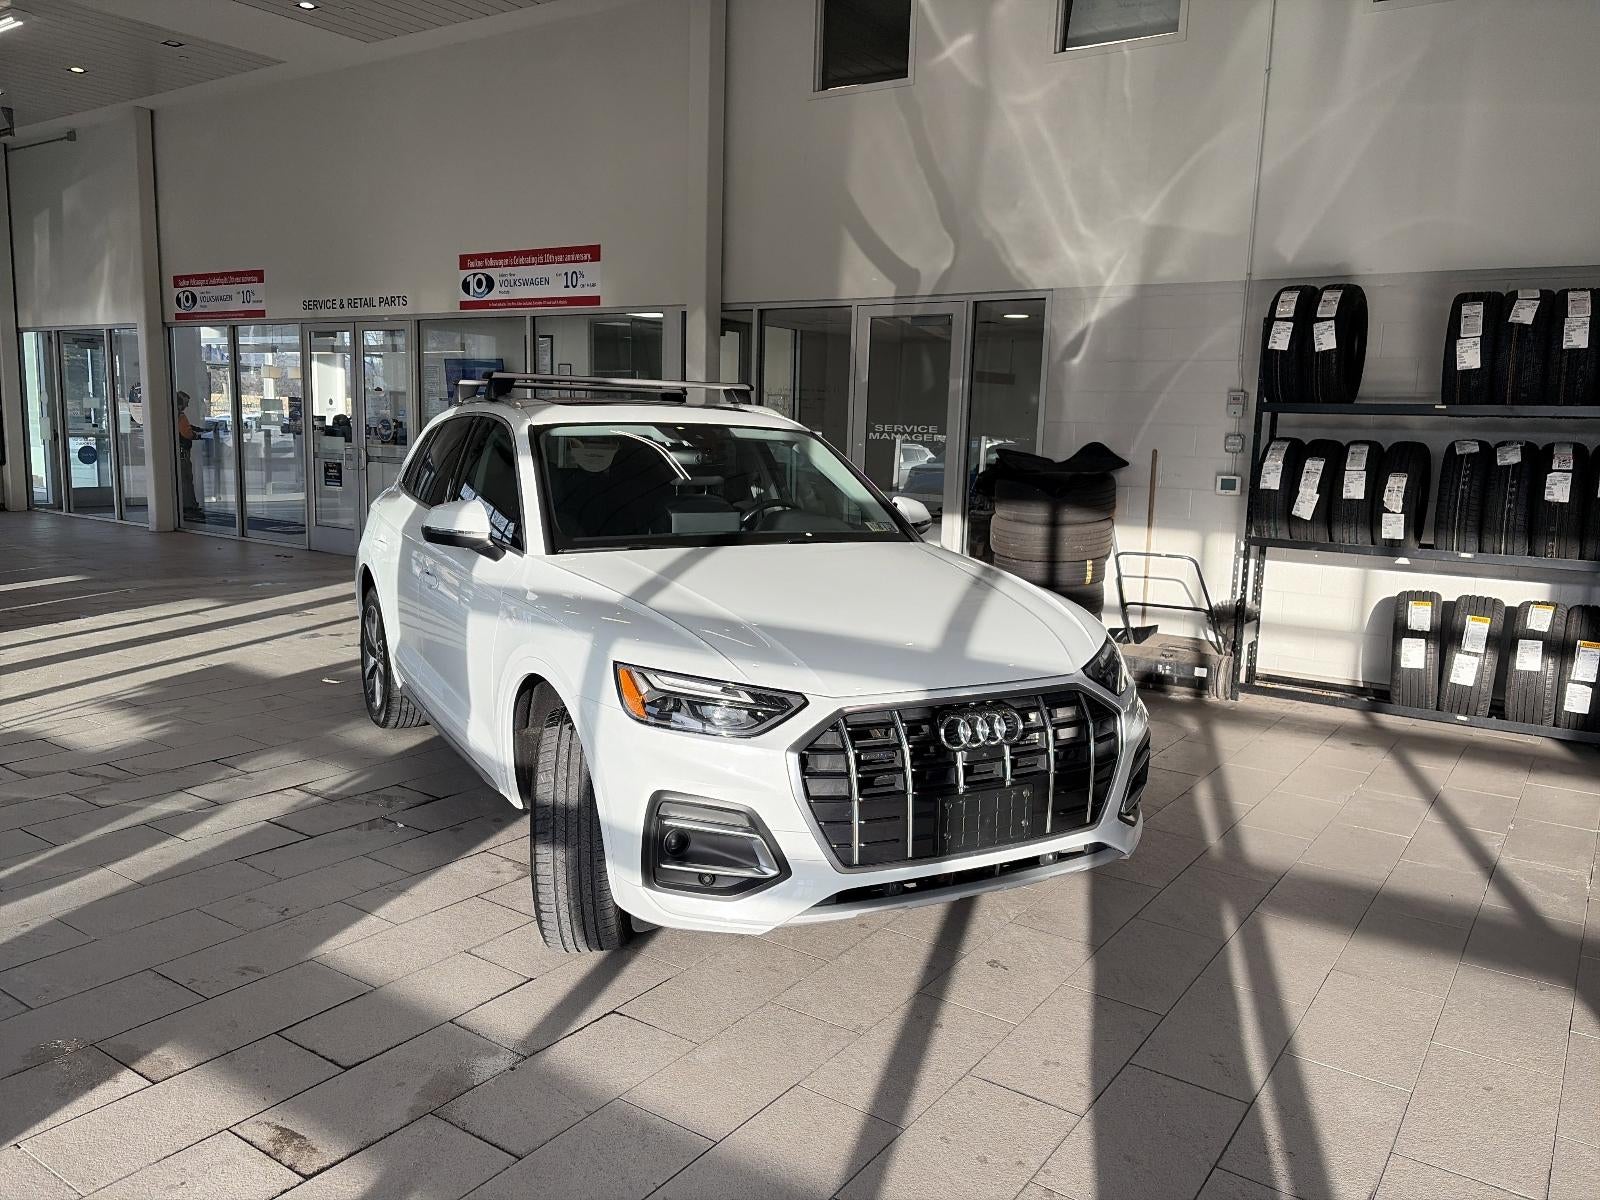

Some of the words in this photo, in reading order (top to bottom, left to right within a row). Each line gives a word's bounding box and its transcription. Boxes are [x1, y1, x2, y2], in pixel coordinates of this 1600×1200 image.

[466, 273, 487, 297] 10
[499, 276, 550, 288] VOLKSWAGEN
[200, 294, 233, 303] VOLKSWAGEN
[302, 299, 337, 310] SERVICE
[339, 299, 345, 309] &
[347, 297, 377, 308] RETAIL
[378, 295, 408, 307] PARTS
[874, 424, 938, 433] SERVICE
[868, 432, 947, 443] MANAGER
